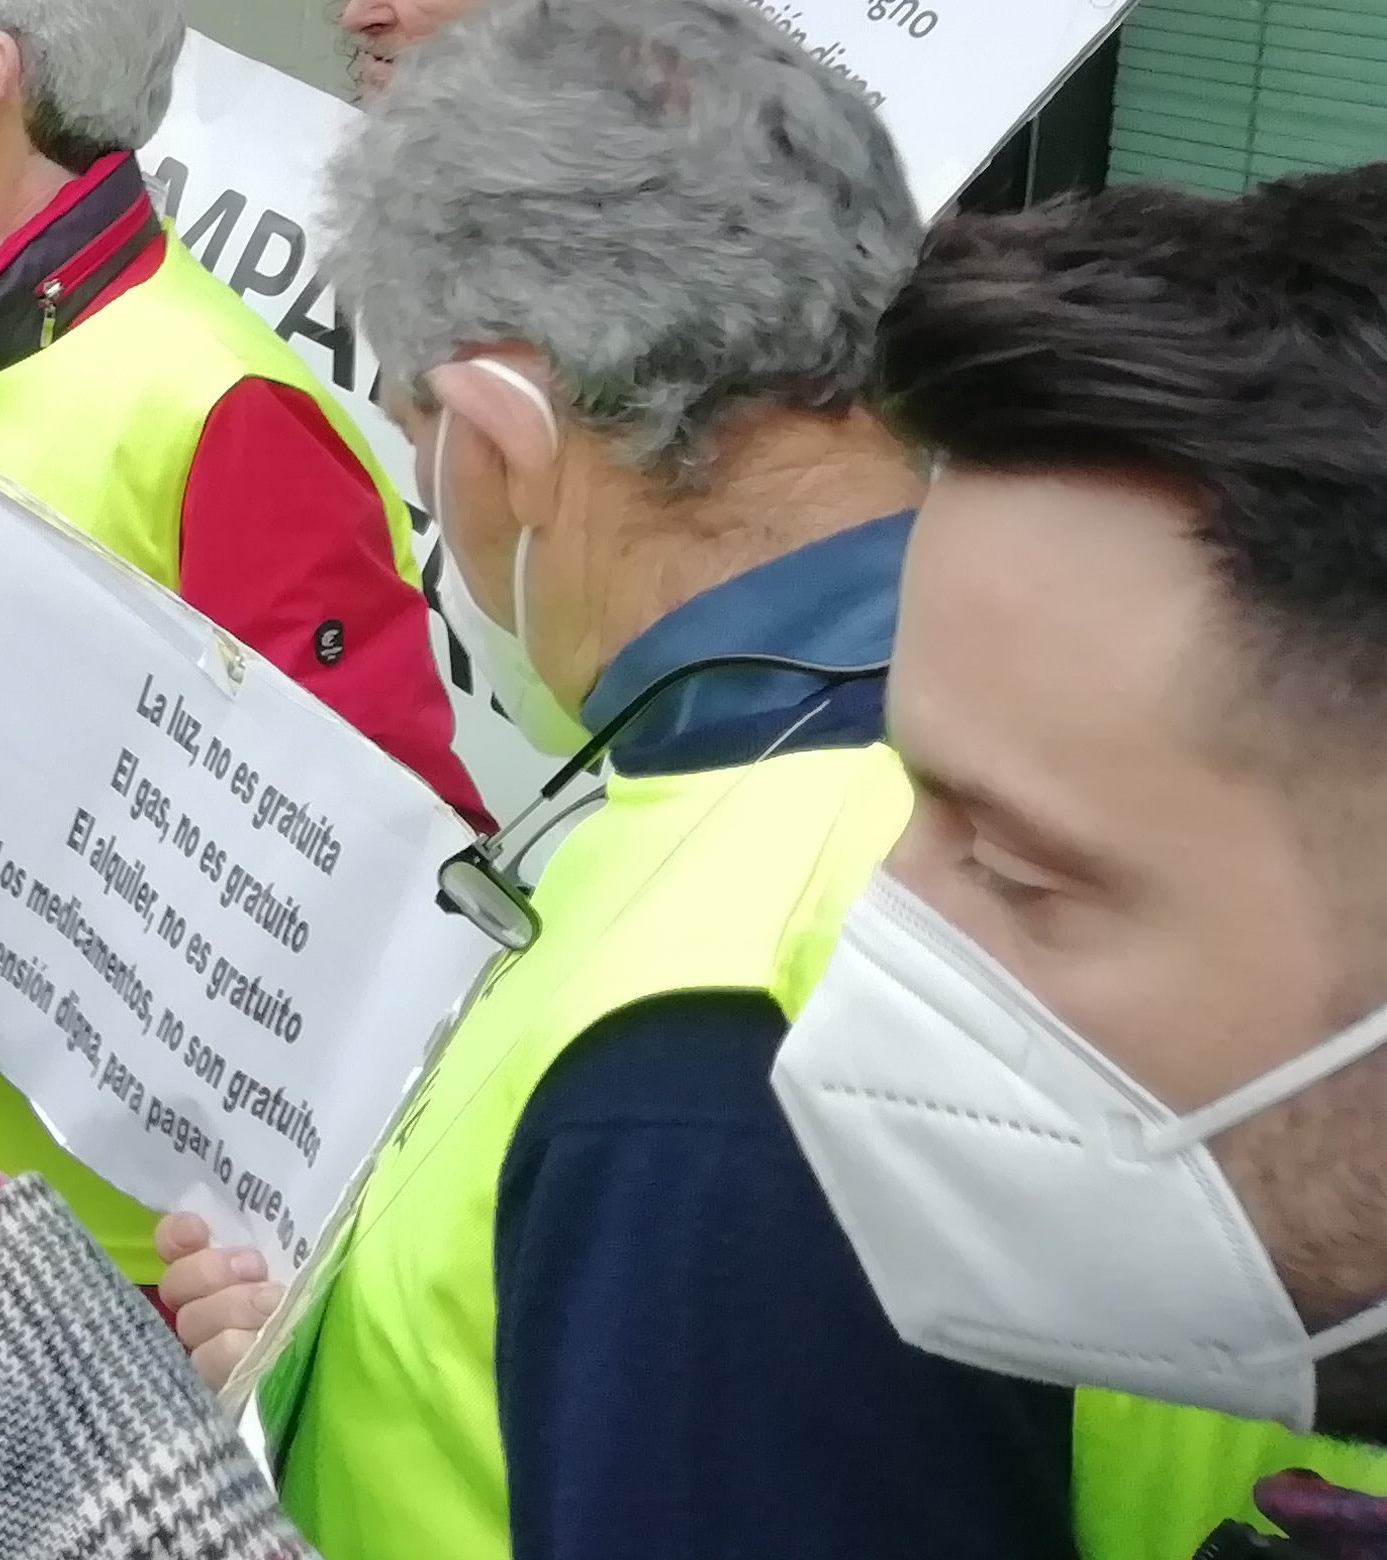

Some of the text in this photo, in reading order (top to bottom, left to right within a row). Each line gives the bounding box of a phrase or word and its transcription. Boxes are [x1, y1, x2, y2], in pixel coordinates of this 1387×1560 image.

[155, 155, 381, 404] MPA
[110, 746, 310, 954] El gas, no es gratuito
[136, 672, 342, 877] La luz, no es gratuita
[25, 878, 153, 1036] medicamentos,
[155, 1007, 185, 1052] no
[183, 1034, 227, 1090] son
[65, 806, 303, 1044] El alquiler, no es gratuito
[53, 990, 102, 1078] digna,
[97, 1051, 145, 1116] para
[145, 1095, 212, 1163] pagar
[212, 1139, 234, 1185] lo
[236, 1170, 283, 1222] que
